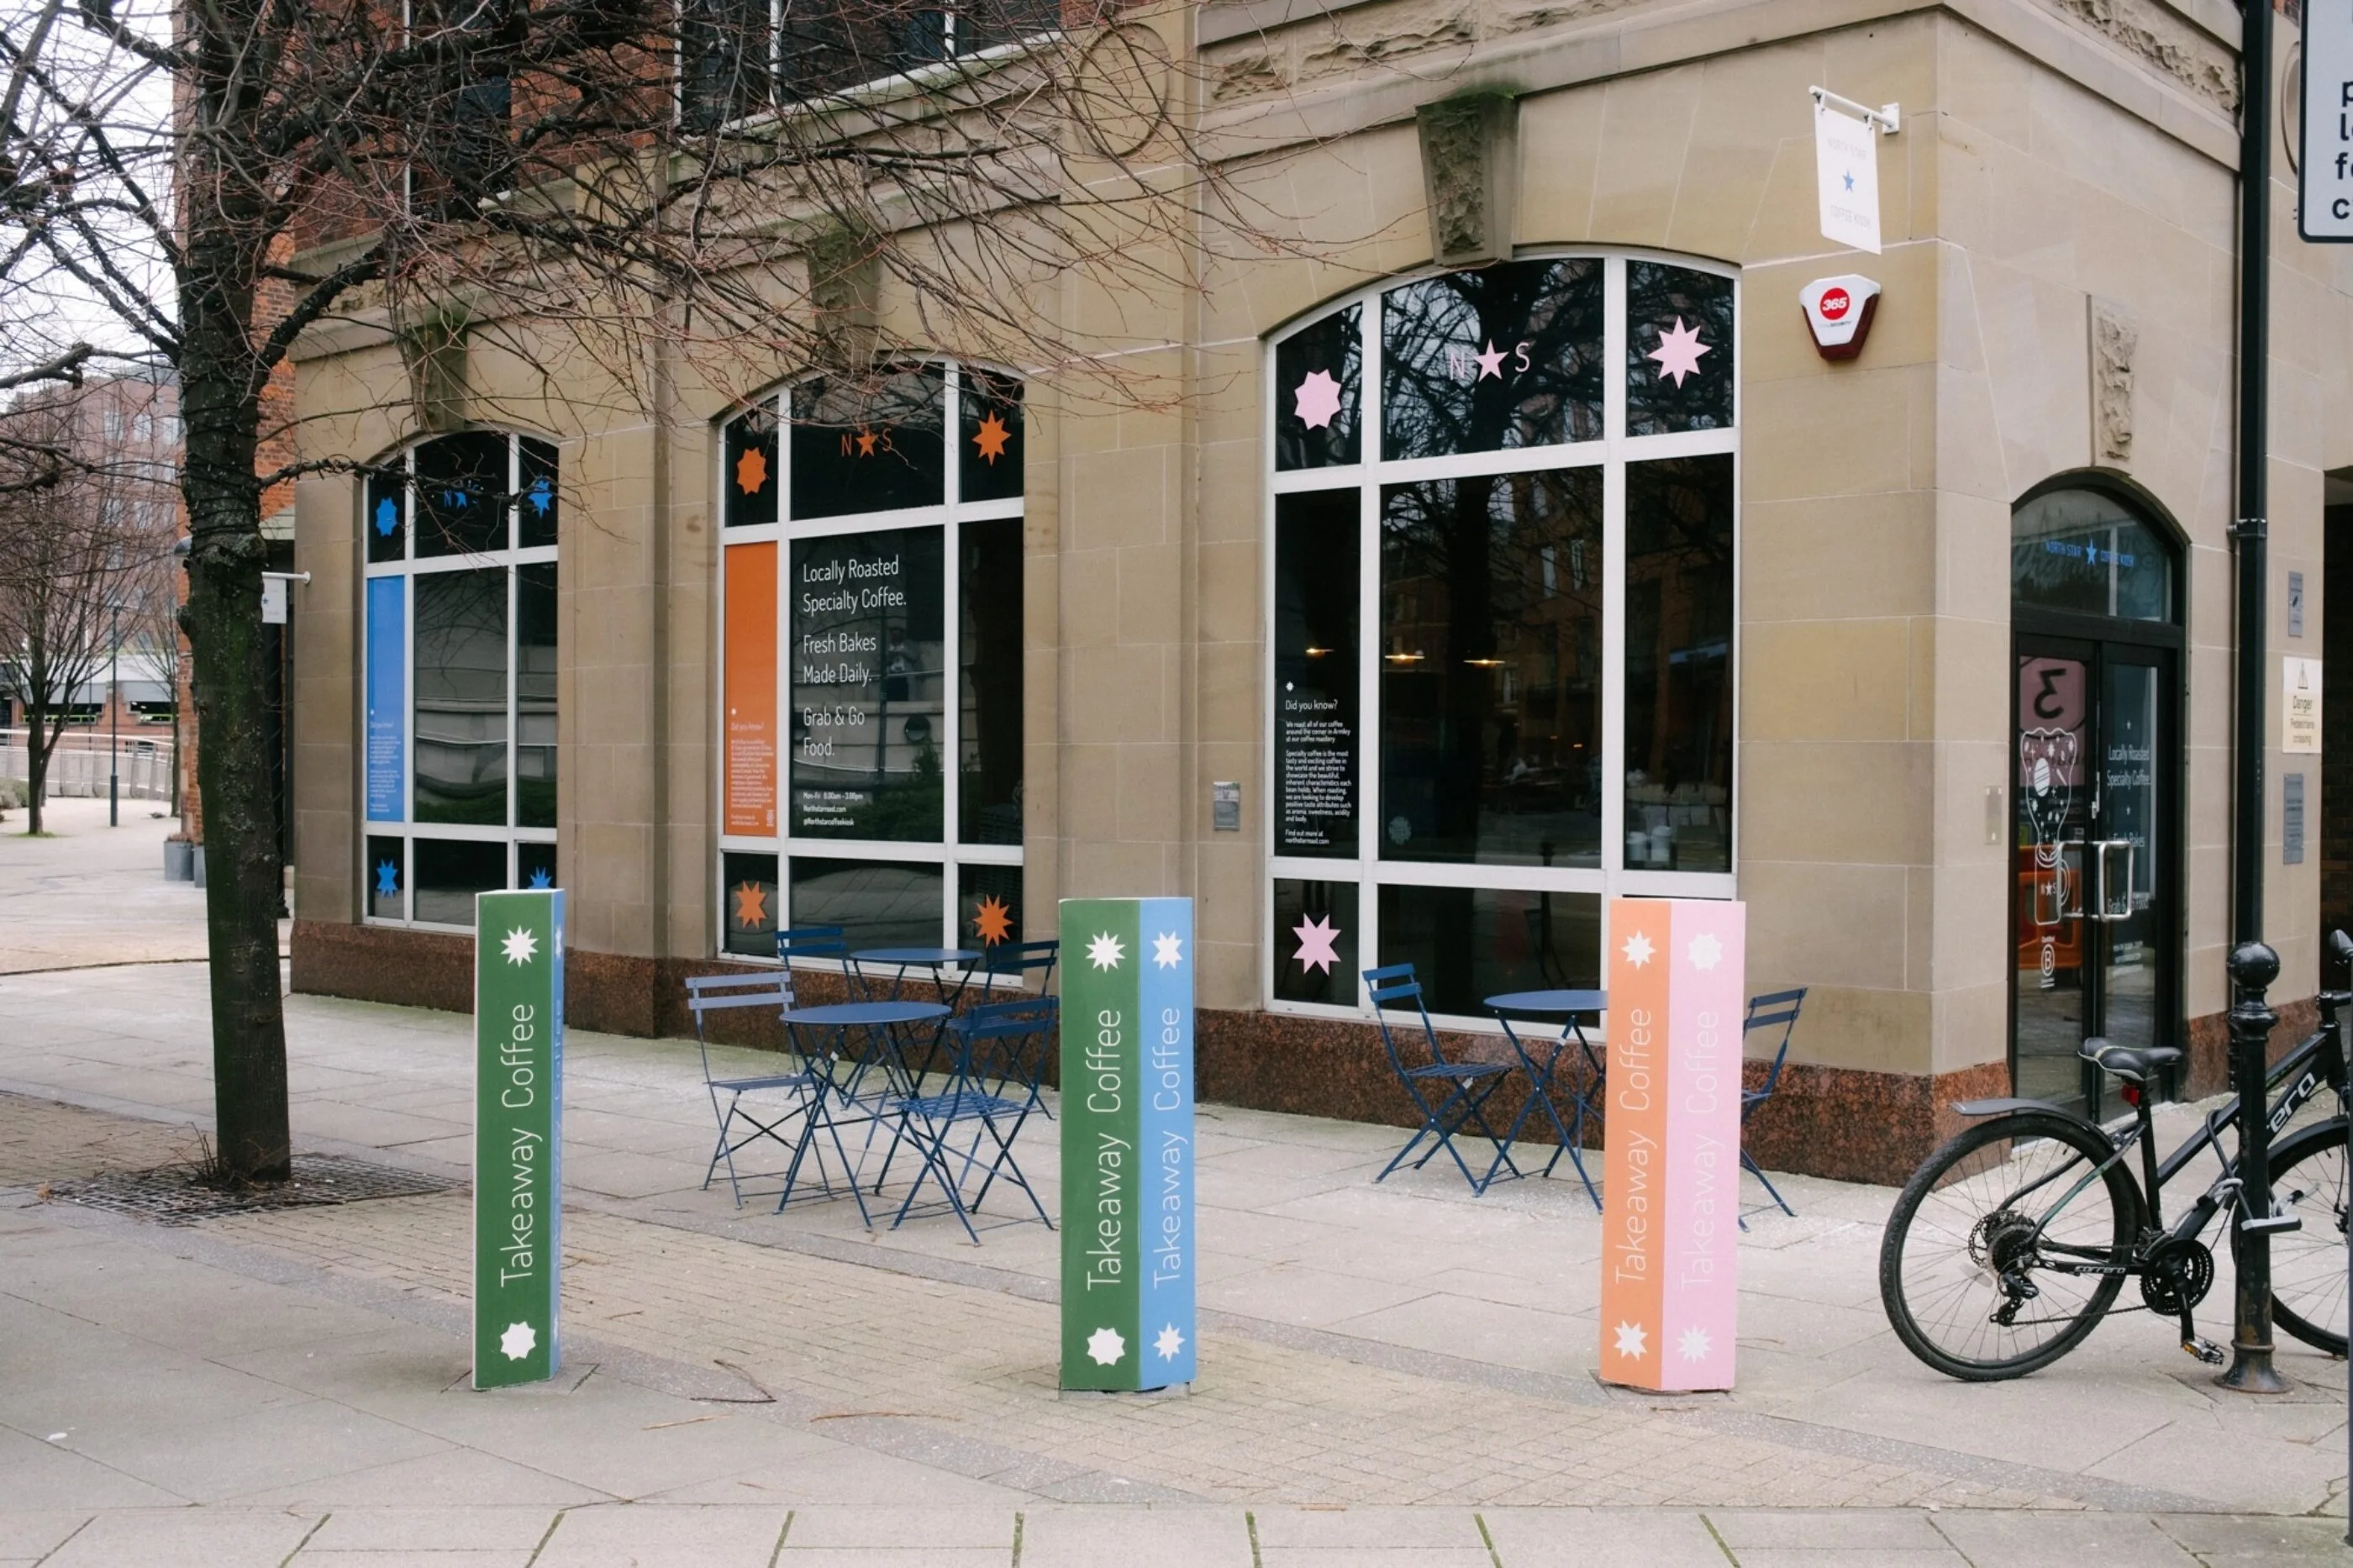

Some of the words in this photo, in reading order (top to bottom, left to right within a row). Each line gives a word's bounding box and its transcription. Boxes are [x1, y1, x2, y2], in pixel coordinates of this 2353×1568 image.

[1822, 297, 1847, 312] 365
[1449, 350, 1466, 381] N
[1514, 341, 1530, 373] S
[841, 433, 852, 458] N
[882, 427, 892, 452] S
[803, 560, 845, 586] Locally
[849, 554, 898, 579] Roasted
[803, 589, 858, 617] Specialty
[862, 586, 907, 608] Coffee.
[803, 634, 835, 655] Fresh
[840, 631, 876, 653] Bakes
[803, 663, 835, 684] Made
[840, 661, 871, 687] Daily.
[803, 706, 831, 727] Grab
[834, 706, 845, 726] &
[849, 706, 865, 725] Go
[1286, 700, 1298, 710] Did
[1298, 702, 1313, 713] you
[1313, 699, 1338, 710] know?
[2292, 696, 2313, 713] Danger
[803, 736, 835, 757] Food.
[2108, 745, 2128, 765] Locally
[2129, 744, 2150, 760] Roasted
[2107, 770, 2131, 790] Specialty
[500, 1004, 534, 1108] Coffee
[1086, 1009, 1121, 1113] Coffee
[1152, 1008, 1181, 1111] Coffee
[1619, 1008, 1651, 1111] Coffee
[1684, 1011, 1719, 1113] Coffee
[500, 1128, 543, 1287] Takeaway
[1086, 1132, 1131, 1291] Takeaway
[1153, 1130, 1188, 1289] Takeaway
[1615, 1129, 1658, 1284] Takeaway
[1682, 1134, 1725, 1291] Takeaway
